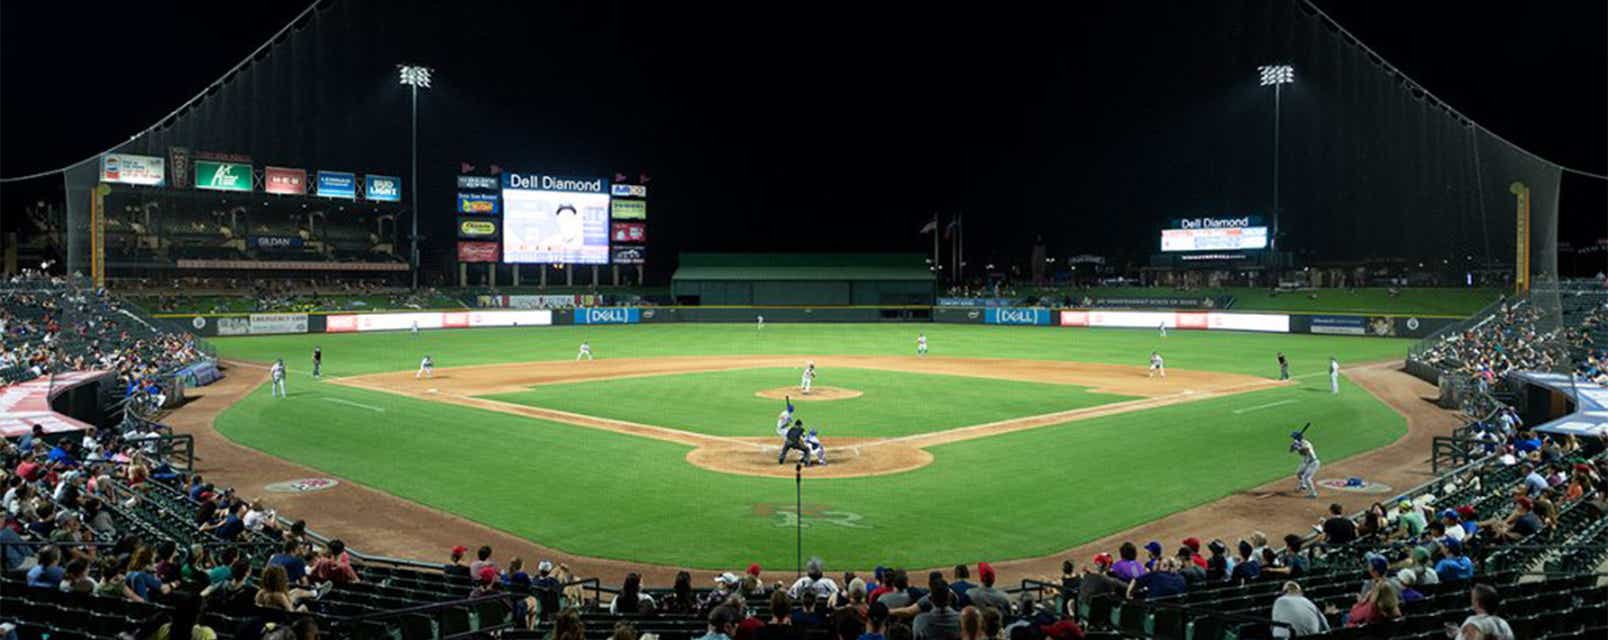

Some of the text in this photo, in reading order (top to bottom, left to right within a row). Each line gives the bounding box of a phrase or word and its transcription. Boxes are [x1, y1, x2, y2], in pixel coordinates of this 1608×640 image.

[373, 179, 394, 189] BUD
[510, 174, 538, 188] Dell
[542, 176, 601, 191] Diamond
[370, 186, 397, 196] LIGHT
[1181, 216, 1249, 229] Dell Diamond
[257, 237, 290, 247] GILDAN
